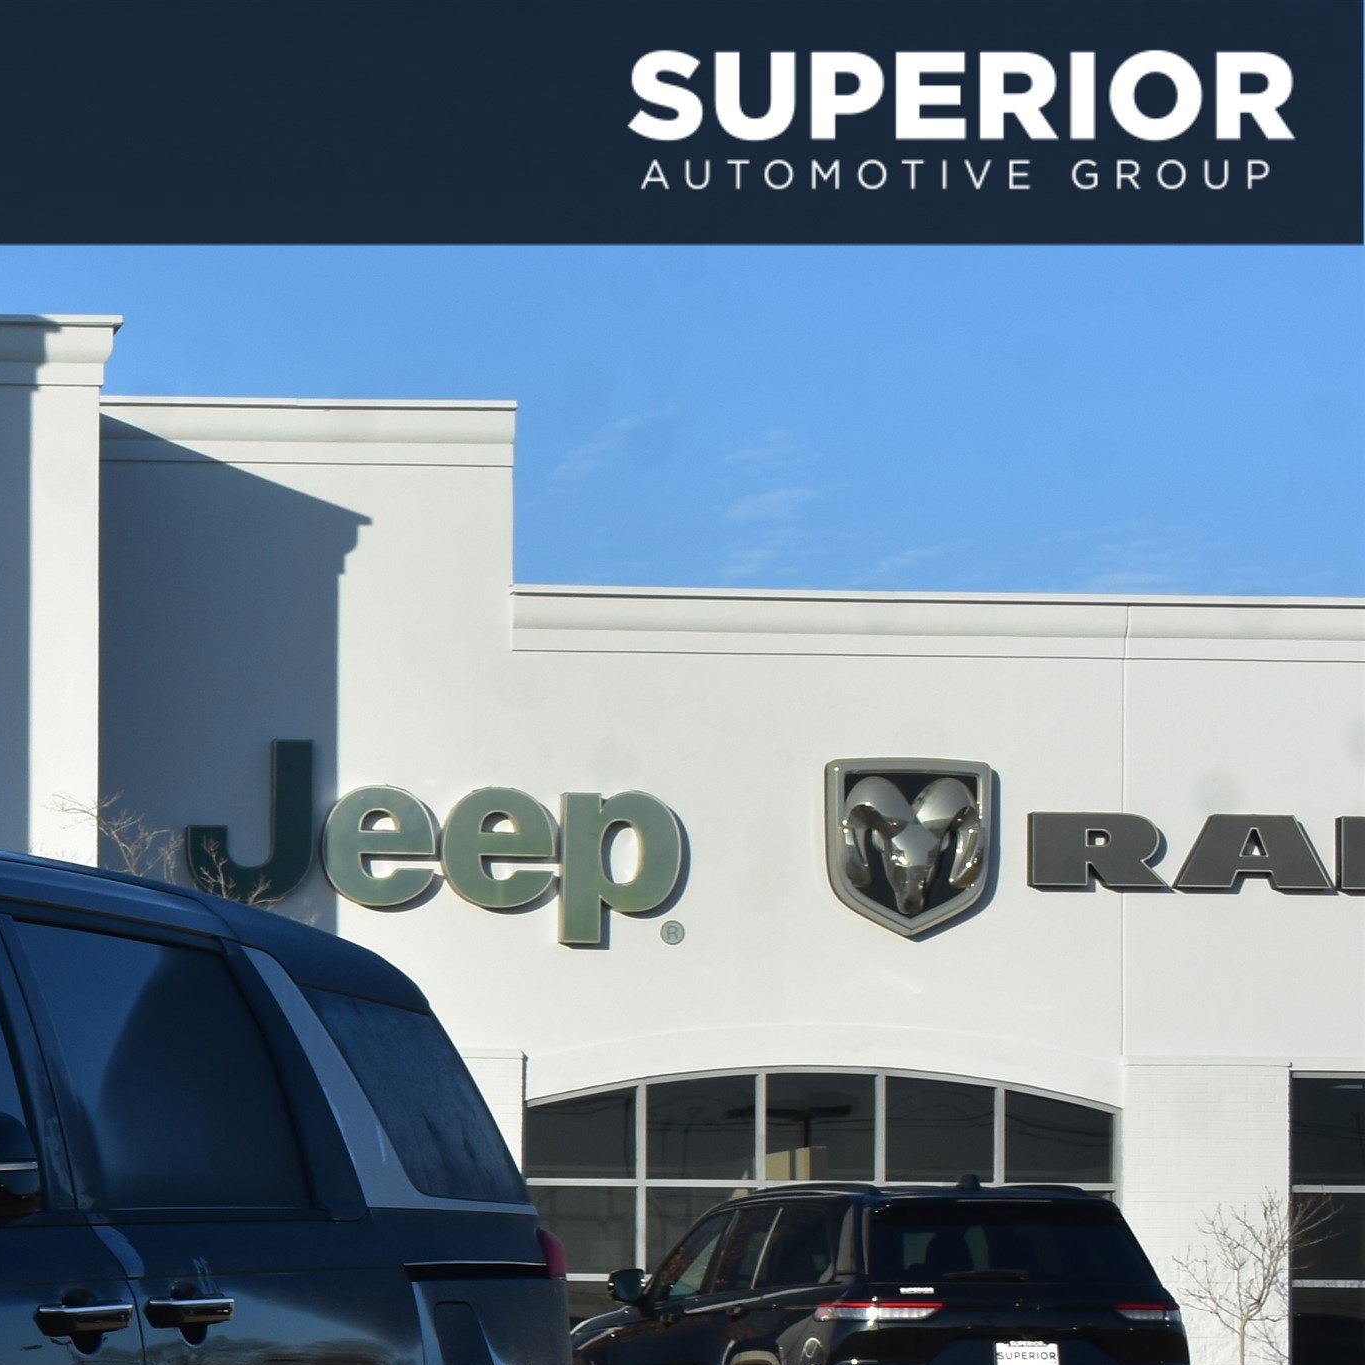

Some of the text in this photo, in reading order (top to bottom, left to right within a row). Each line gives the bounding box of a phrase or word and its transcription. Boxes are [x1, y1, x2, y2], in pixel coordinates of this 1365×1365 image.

[185, 738, 684, 945] Jeep
[1027, 810, 1365, 892] RA
[997, 1351, 1057, 1361] SUPERIOR
